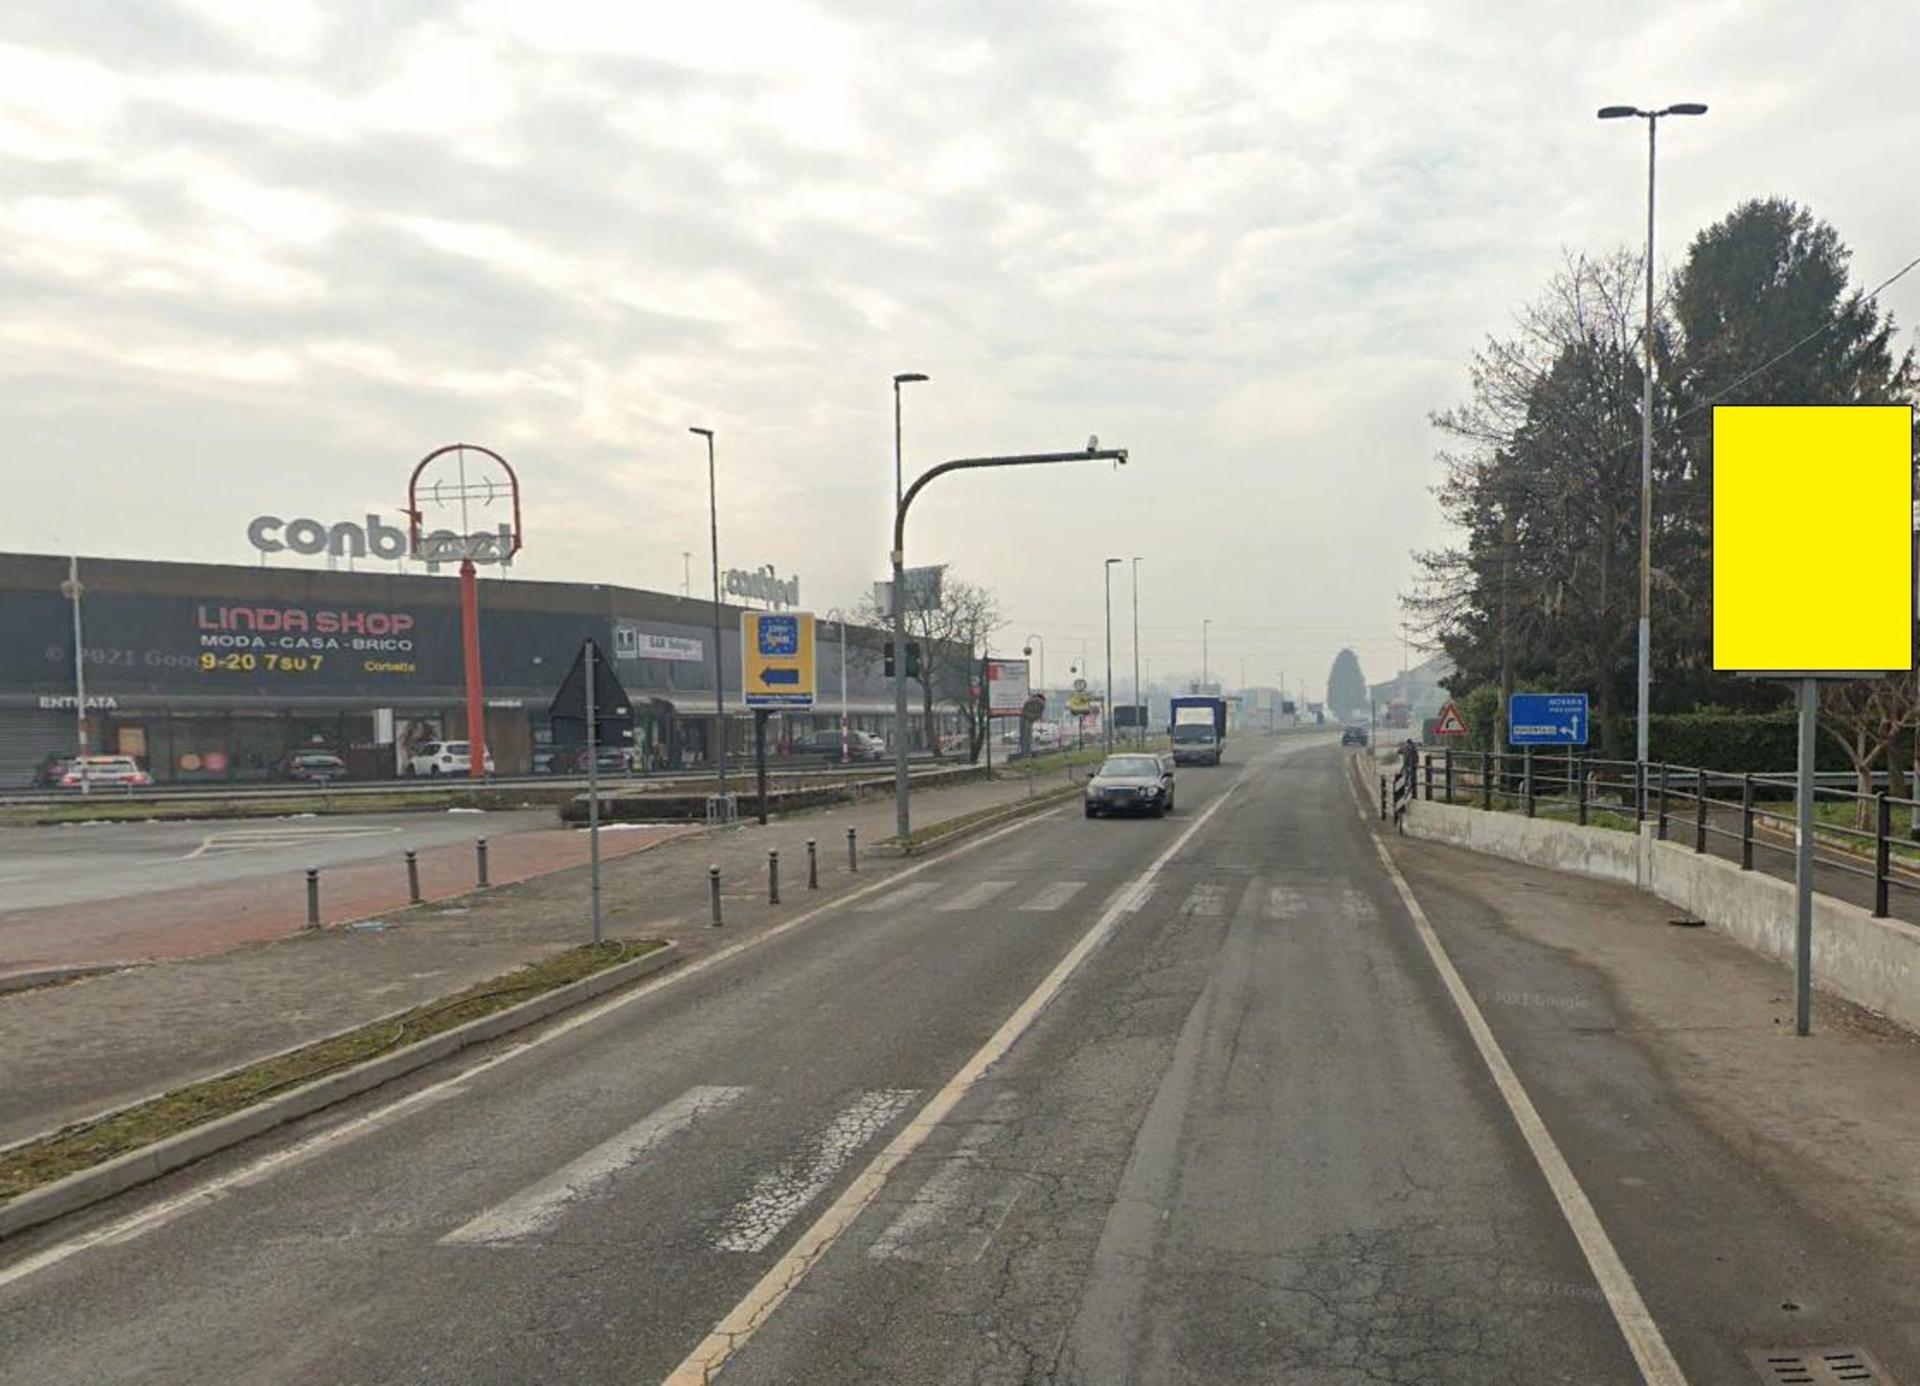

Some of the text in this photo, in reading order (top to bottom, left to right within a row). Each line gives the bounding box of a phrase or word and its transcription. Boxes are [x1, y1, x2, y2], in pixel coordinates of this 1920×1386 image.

[199, 605, 414, 635] LINDA SHOP
[201, 653, 256, 671] 9-20
